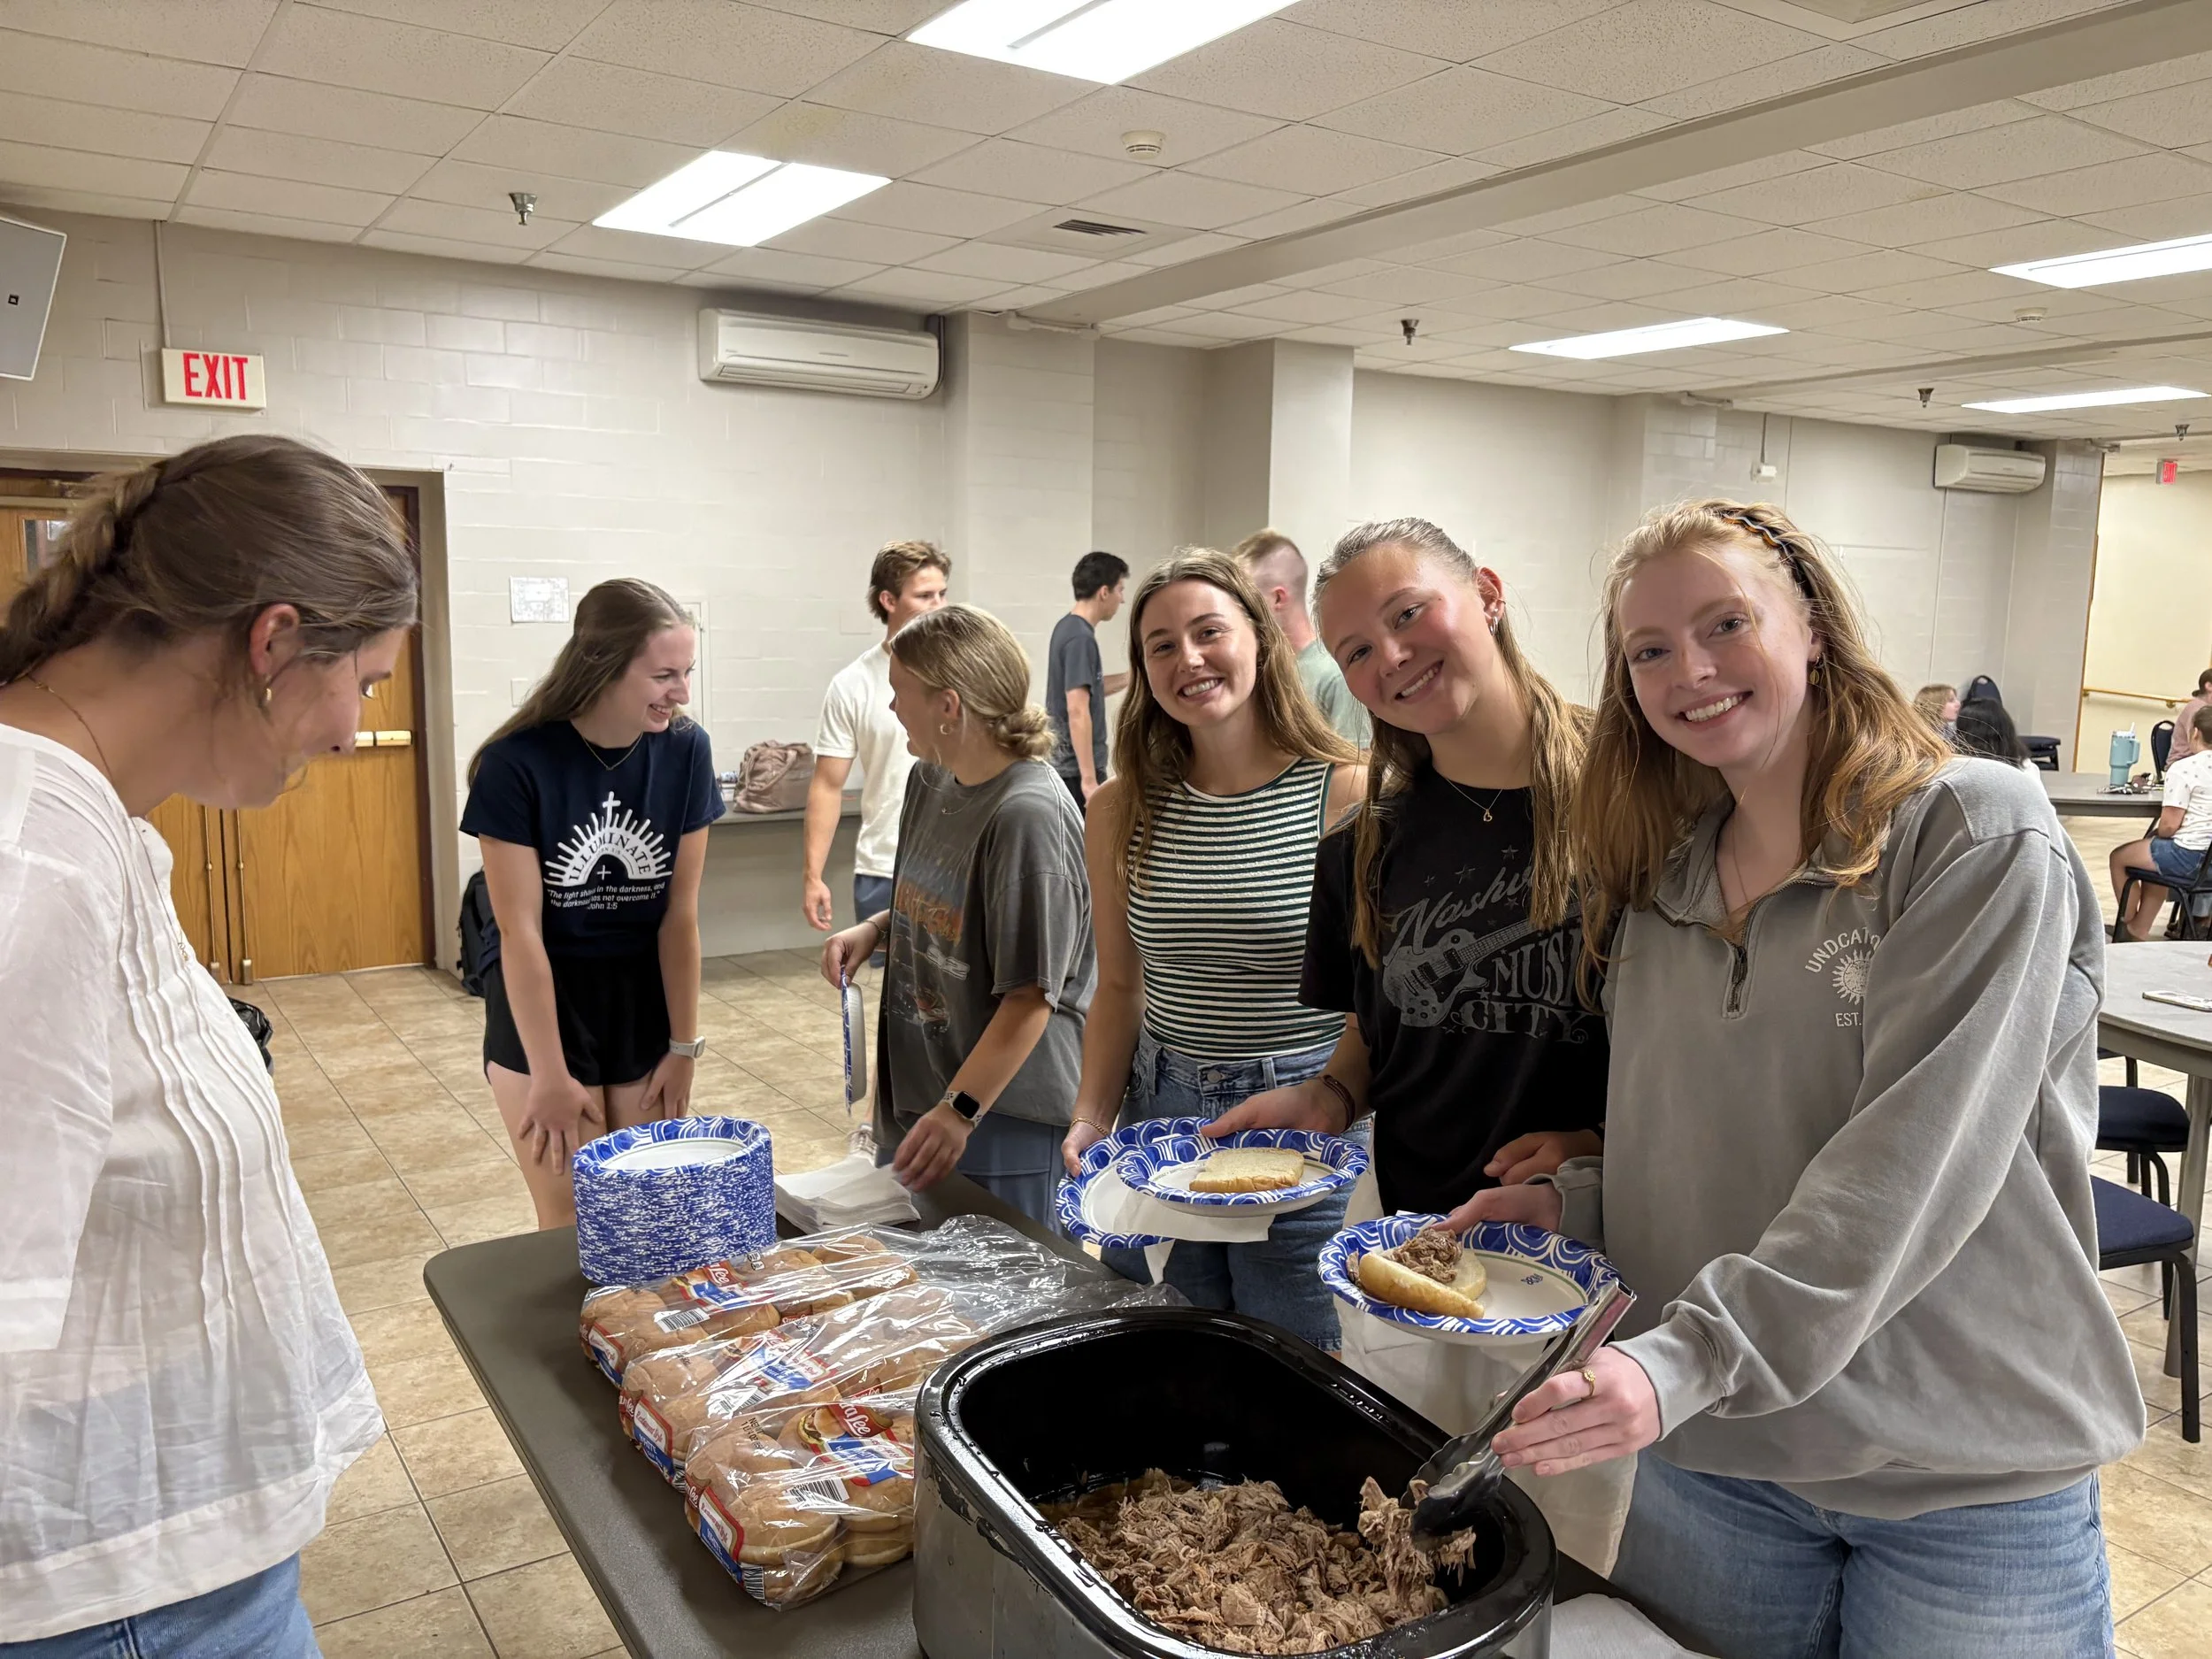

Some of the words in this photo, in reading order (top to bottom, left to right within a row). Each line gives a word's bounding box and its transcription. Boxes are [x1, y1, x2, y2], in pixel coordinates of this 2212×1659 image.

[182, 352, 248, 400] EXIT
[569, 833, 651, 880] ILLUMINATE
[550, 898, 562, 907] the
[603, 893, 614, 902] not
[616, 893, 649, 902] overcome
[564, 890, 579, 901] light
[653, 881, 665, 890] and
[588, 901, 604, 910] John
[1492, 927, 1586, 1007] MUSI
[1455, 998, 1594, 1044] CITY
[1835, 1012, 1863, 1027] EST.
[845, 1414, 872, 1438] Lee
[638, 1432, 657, 1455] WHITE
